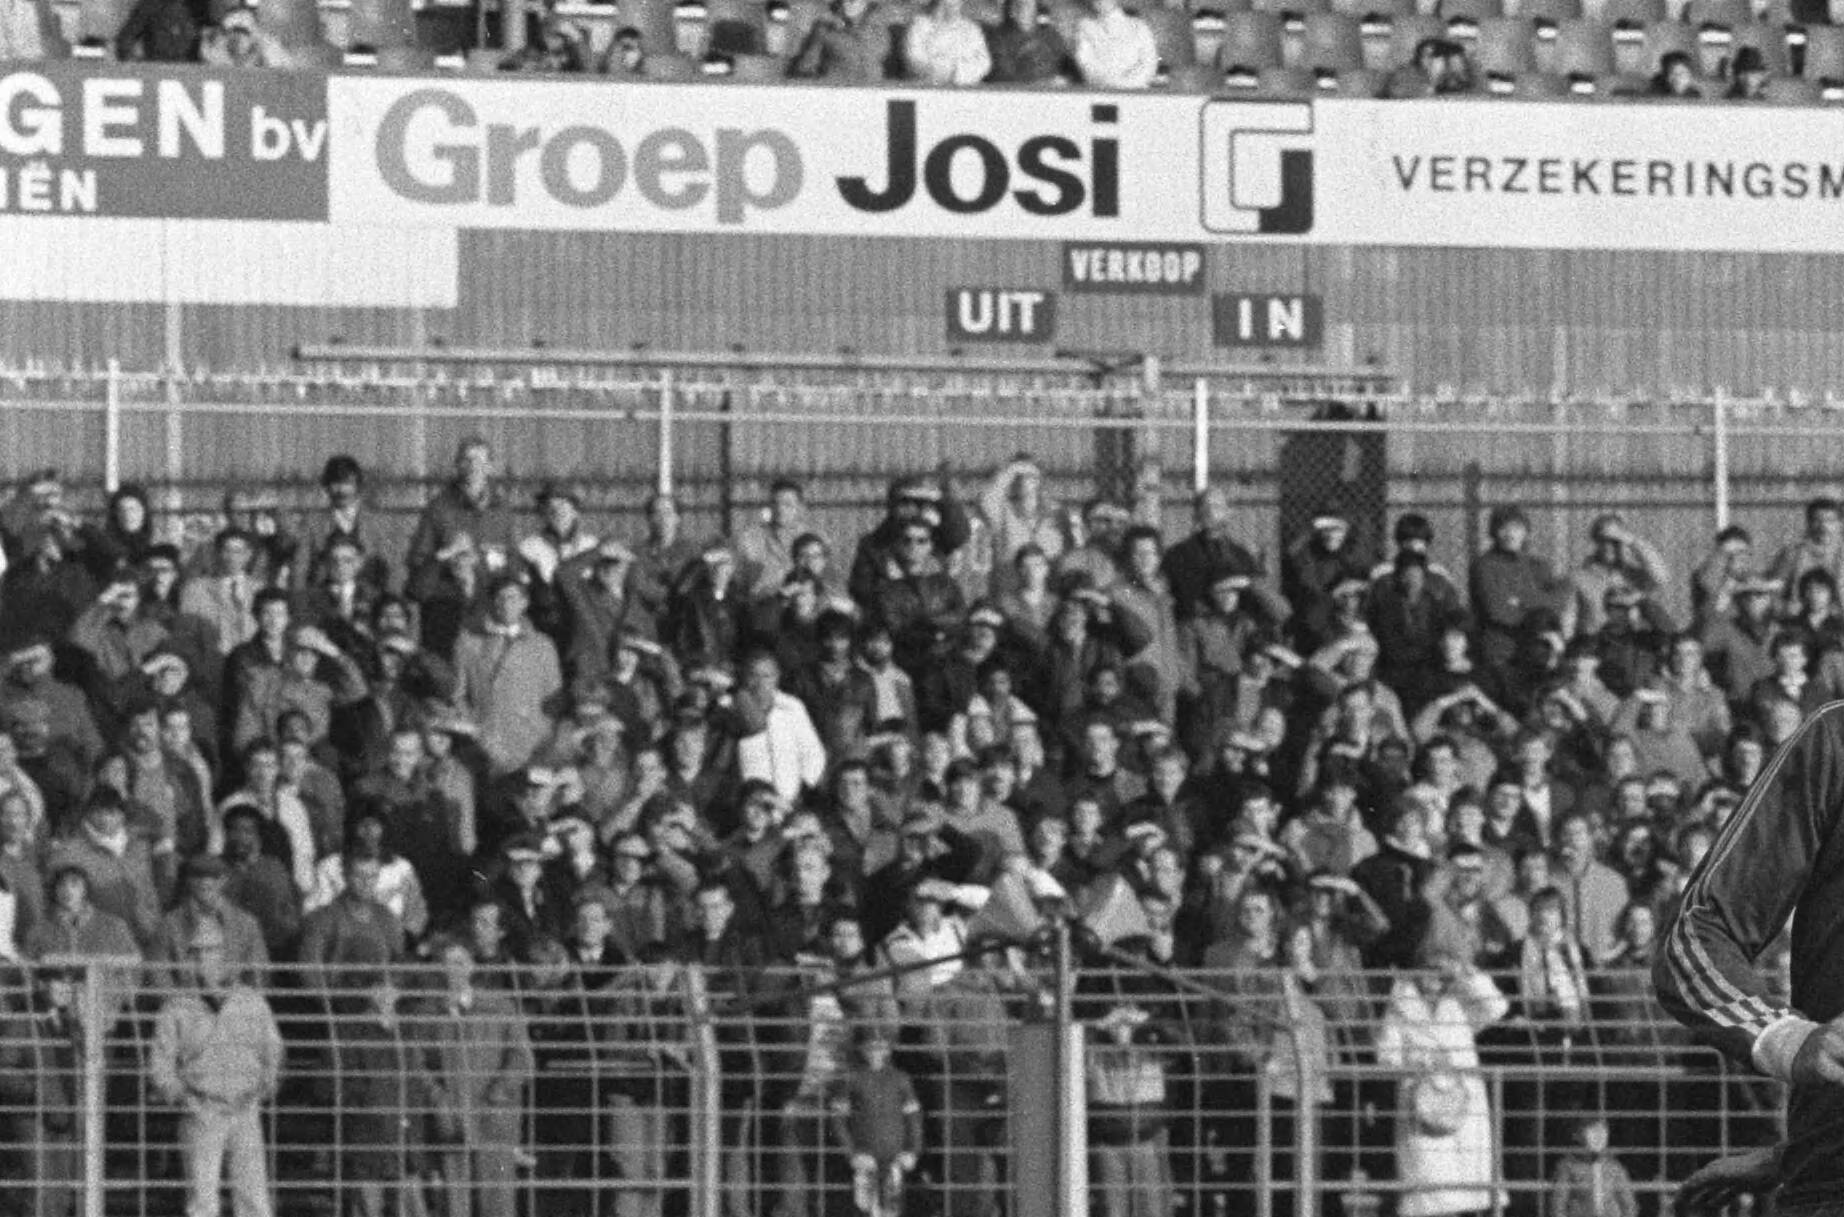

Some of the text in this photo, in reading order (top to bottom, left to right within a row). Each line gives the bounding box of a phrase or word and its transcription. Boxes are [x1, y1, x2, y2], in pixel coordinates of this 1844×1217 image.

[252, 105, 328, 162] bv
[376, 88, 1119, 224] Groep Josi
[1070, 249, 1199, 283] VERKOOP
[958, 291, 1045, 333] UIT
[1237, 298, 1303, 339] IN
